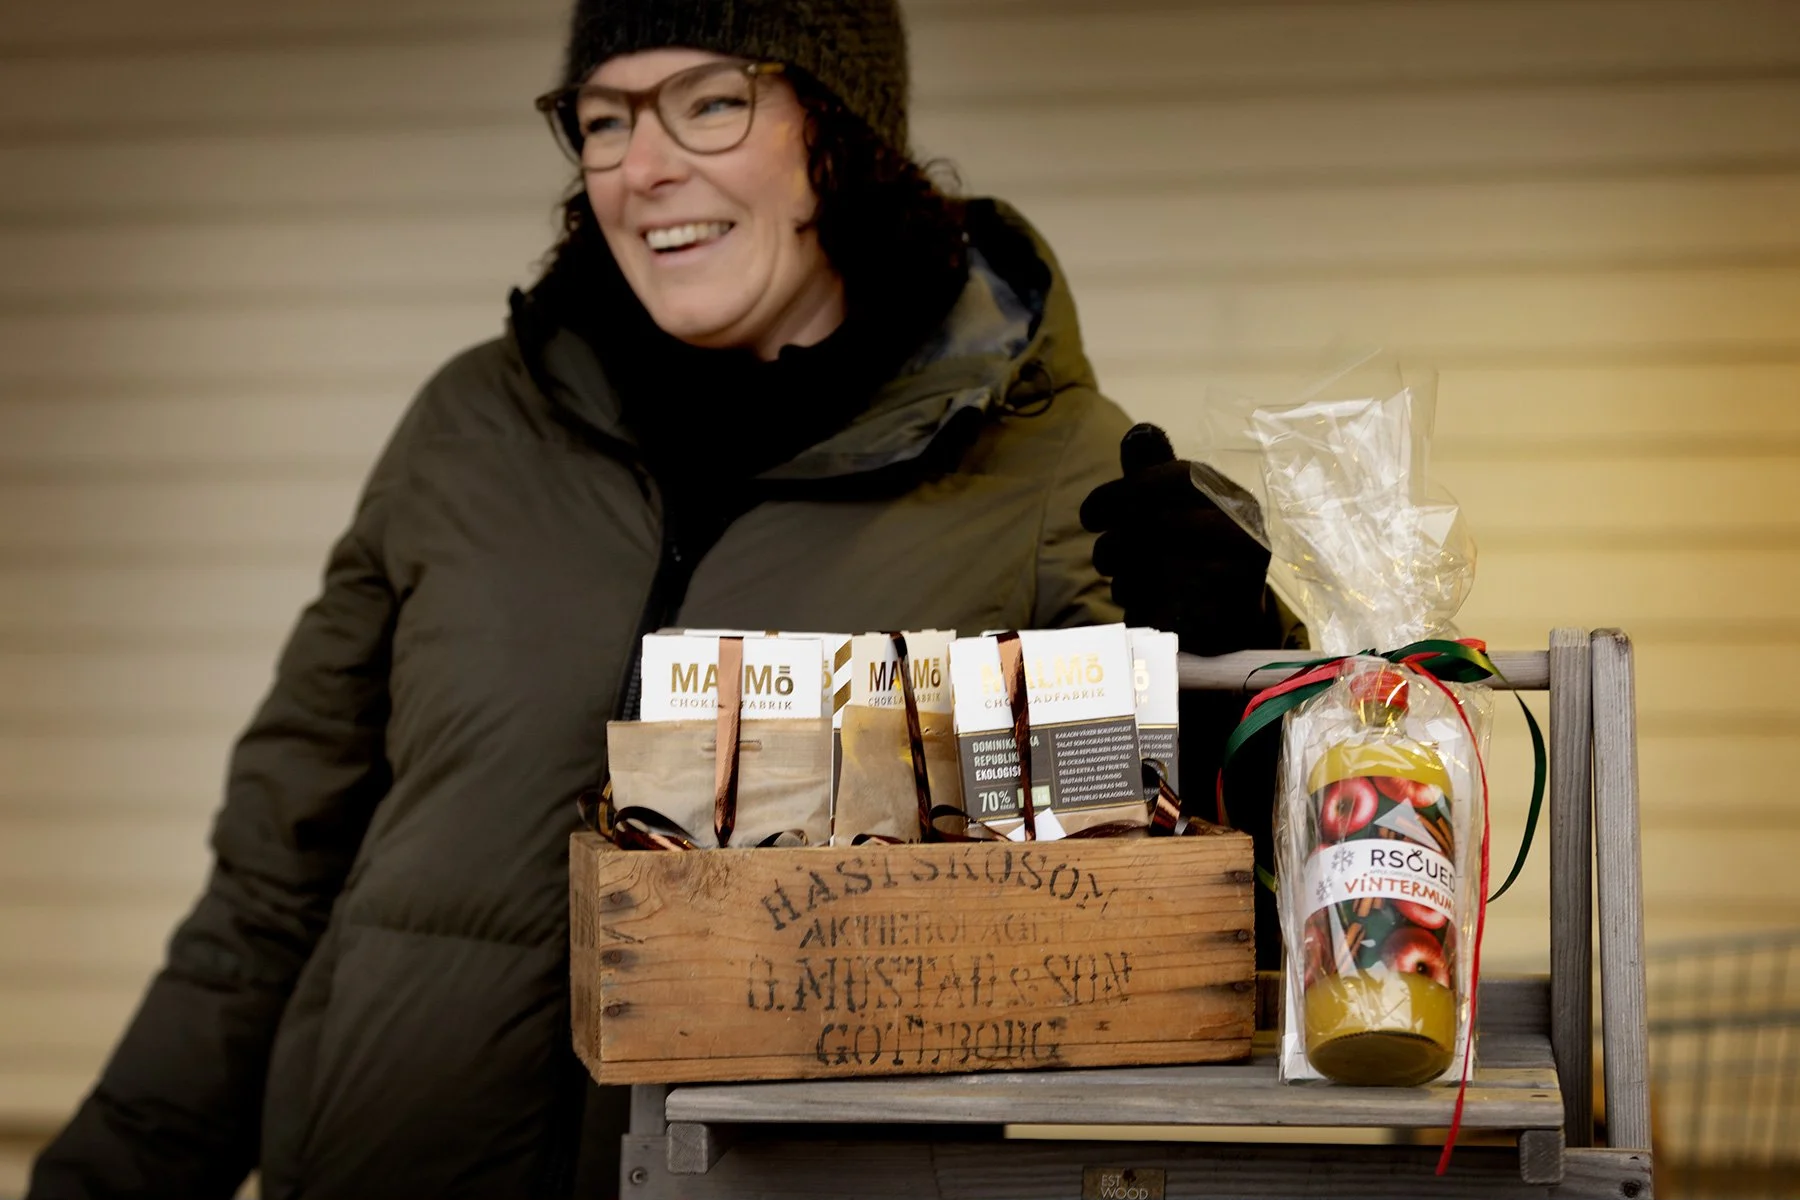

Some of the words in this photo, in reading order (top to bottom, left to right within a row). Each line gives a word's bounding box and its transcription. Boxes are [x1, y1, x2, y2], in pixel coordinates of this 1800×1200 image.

[975, 765, 1021, 782] EKOLOGIS
[979, 789, 1011, 813] 70%
[1101, 1174, 1120, 1187] EST
[1101, 1187, 1149, 1200] WOOD
